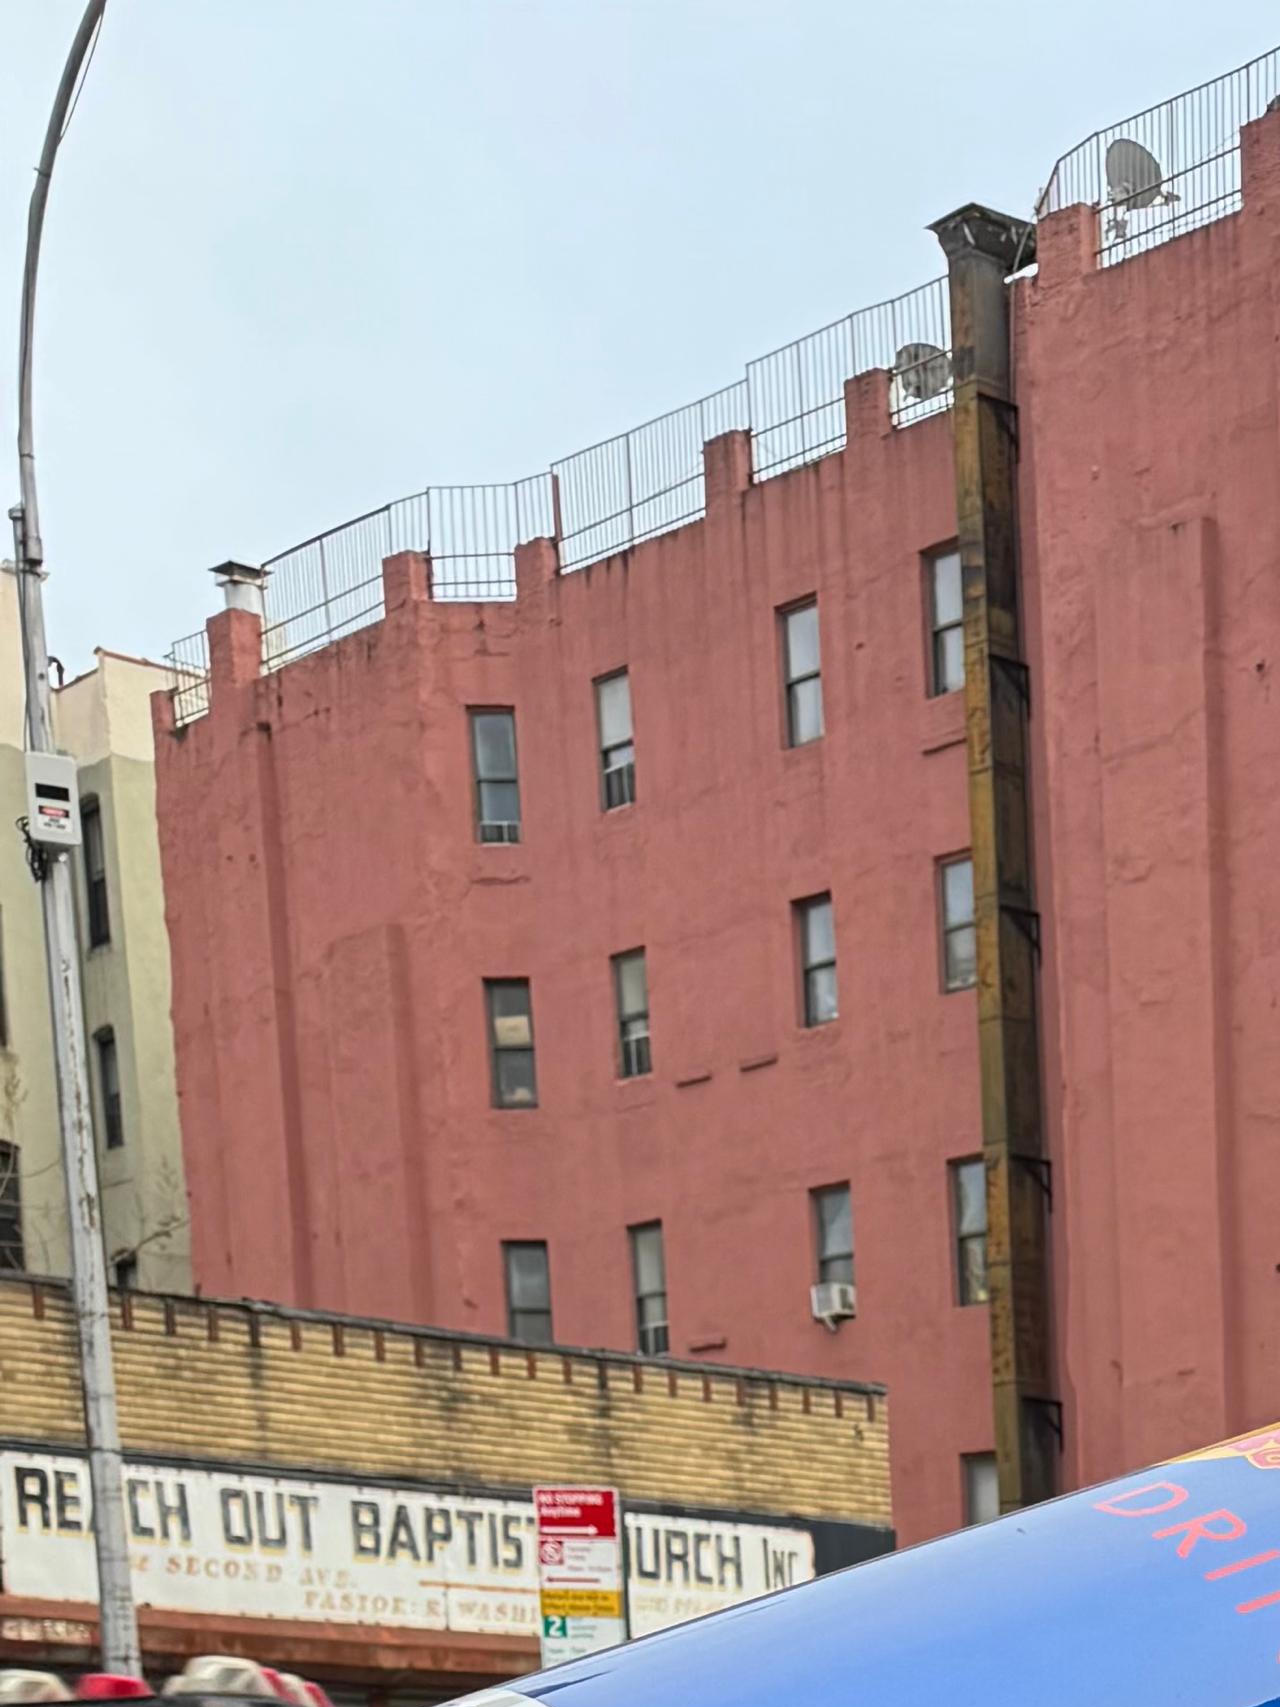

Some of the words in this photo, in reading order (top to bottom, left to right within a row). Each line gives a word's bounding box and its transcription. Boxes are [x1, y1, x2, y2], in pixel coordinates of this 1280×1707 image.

[15, 1466, 191, 1541] RECH
[221, 1488, 319, 1551] OUT
[636, 1526, 743, 1589] URCH
[166, 1555, 283, 1583] SECOND
